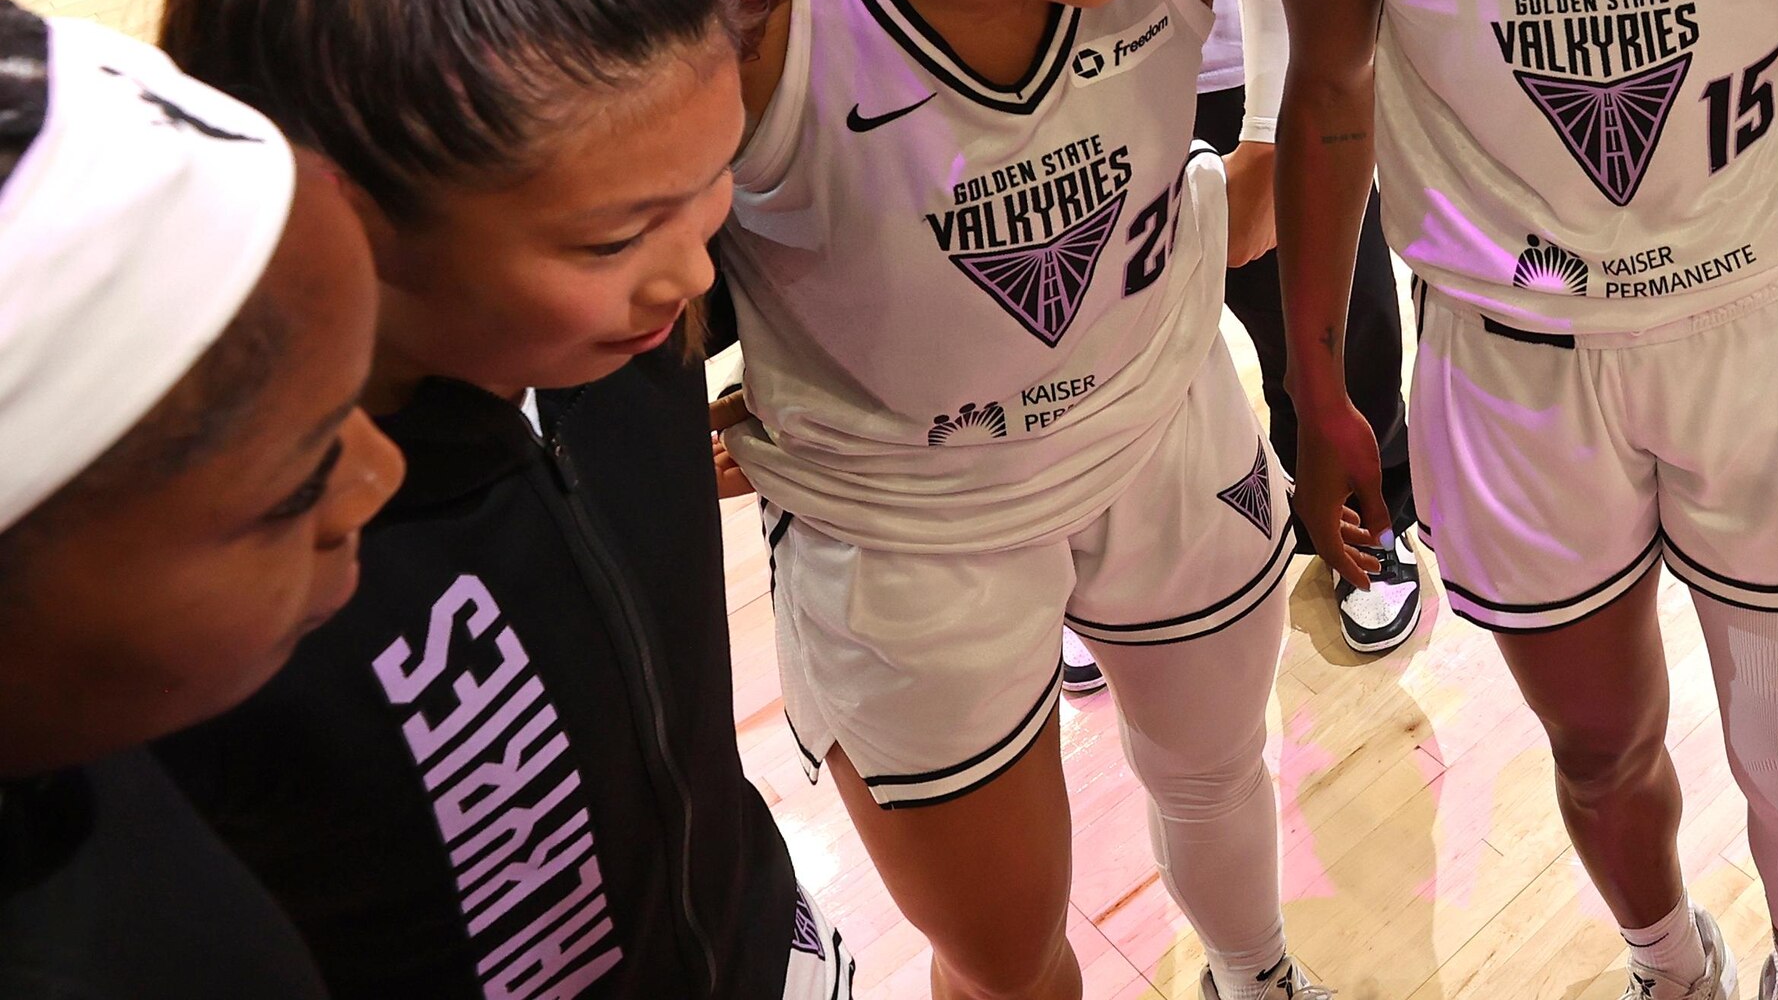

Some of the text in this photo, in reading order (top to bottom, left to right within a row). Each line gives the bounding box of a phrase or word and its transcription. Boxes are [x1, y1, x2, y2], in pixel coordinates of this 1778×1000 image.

[1113, 15, 1169, 66] freedom
[1490, 2, 1700, 78] VALKYRIES
[924, 145, 1132, 252] VALKYRIES
[953, 134, 1104, 205] GOLDEN STATE
[1121, 165, 1184, 298] 2
[1602, 246, 1674, 277] KAISER
[1606, 244, 1757, 299] PERMANENTE
[1021, 375, 1095, 406] KAISER
